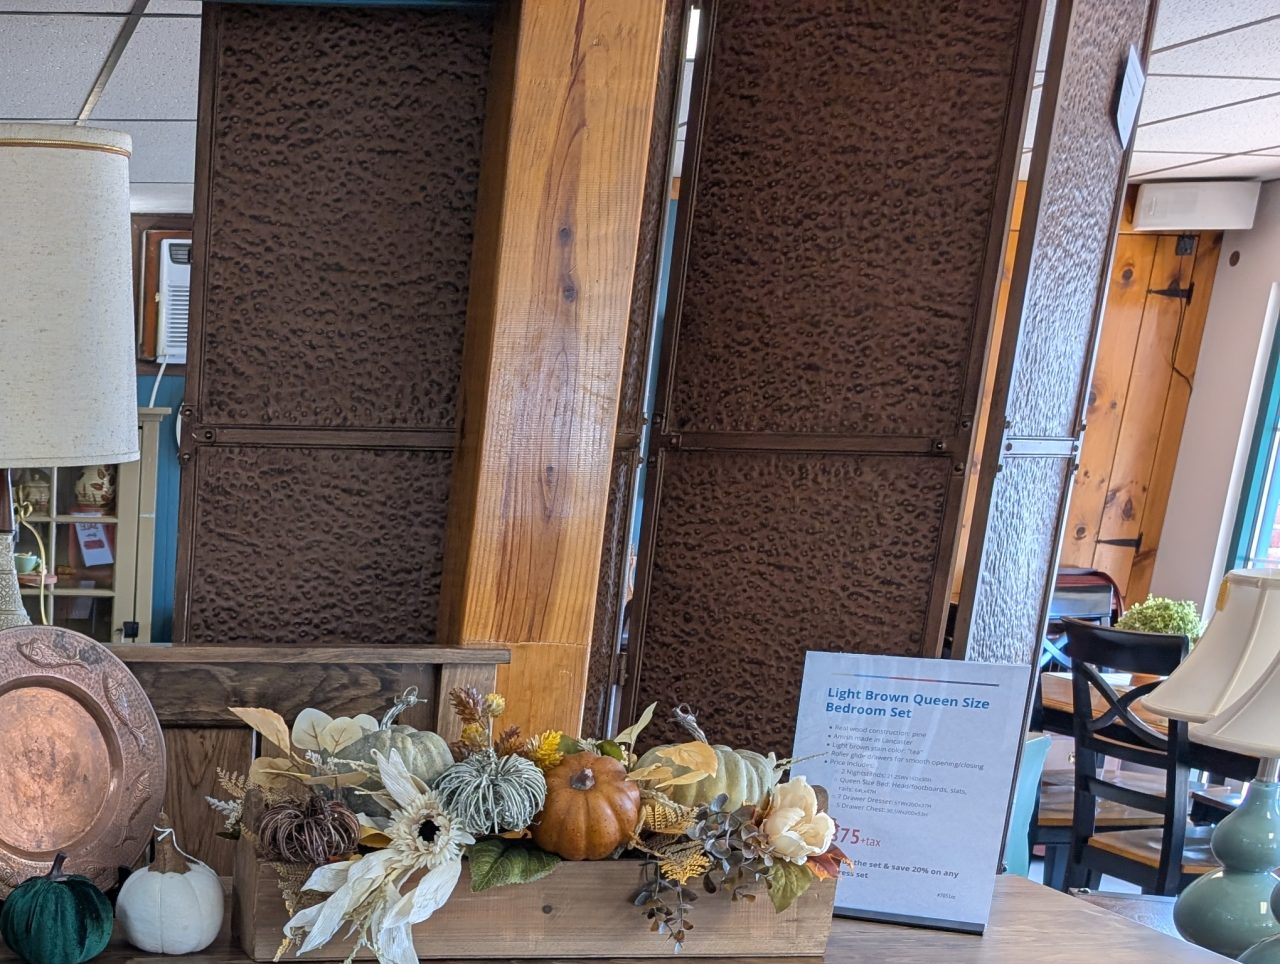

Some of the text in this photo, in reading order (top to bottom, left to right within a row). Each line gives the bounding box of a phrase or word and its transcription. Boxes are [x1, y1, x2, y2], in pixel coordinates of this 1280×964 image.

[828, 688, 990, 709] Light Brown Queen Size
[825, 702, 912, 718] Bedroom Set
[848, 743, 870, 751] brown
[867, 753, 893, 761] drawers
[905, 757, 931, 765] smooth
[931, 760, 984, 770] opening/closing
[840, 777, 861, 785] Queen
[856, 871, 869, 879] set
[891, 864, 911, 872] save
[911, 866, 929, 874] 20%
[943, 871, 959, 879] any
